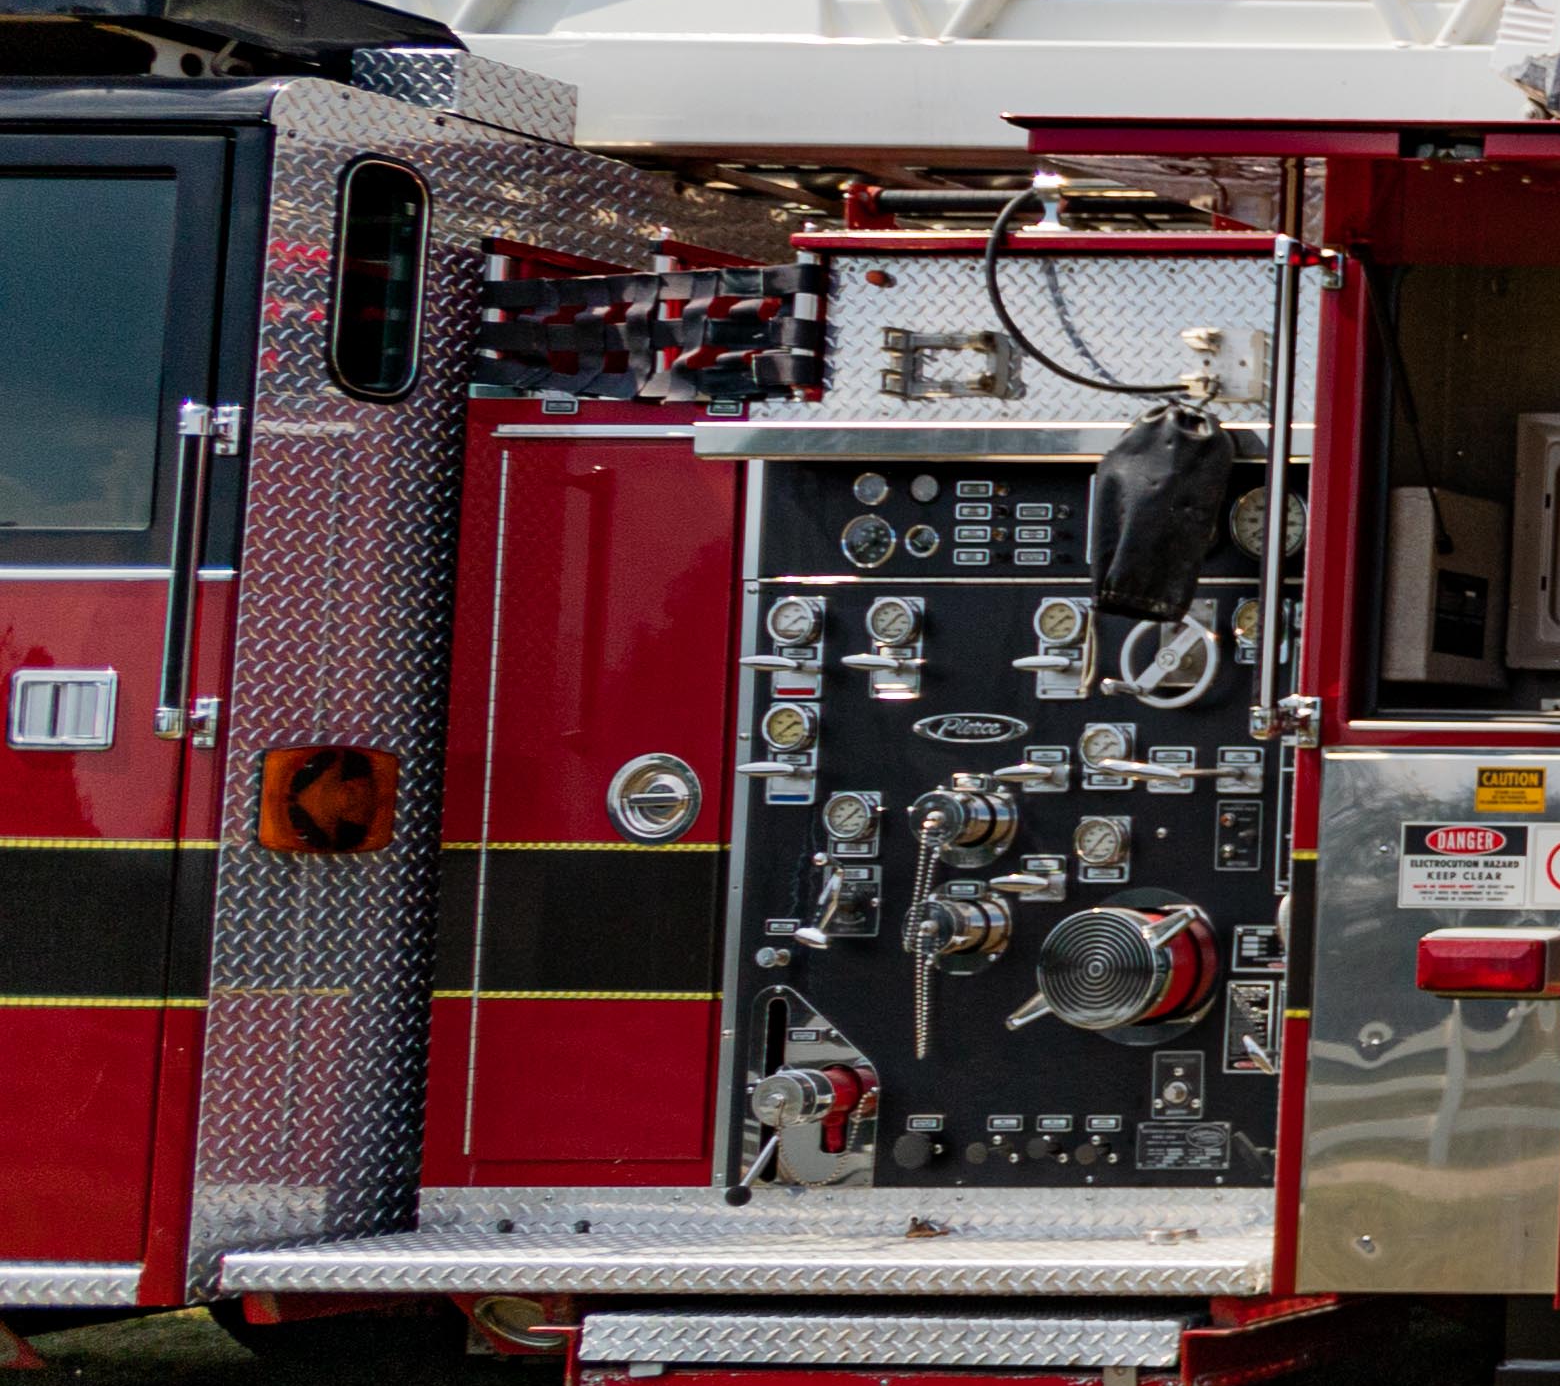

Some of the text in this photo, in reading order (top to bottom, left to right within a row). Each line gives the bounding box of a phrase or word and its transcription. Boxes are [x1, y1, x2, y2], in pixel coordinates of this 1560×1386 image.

[936, 717, 1002, 738] Pierce
[1482, 772, 1539, 786] CAUTION
[1437, 830, 1494, 849] DANGER
[1410, 859, 1520, 868] ELECTROCUTION HAZARD
[1427, 872, 1502, 880] KEEP CLEAR
